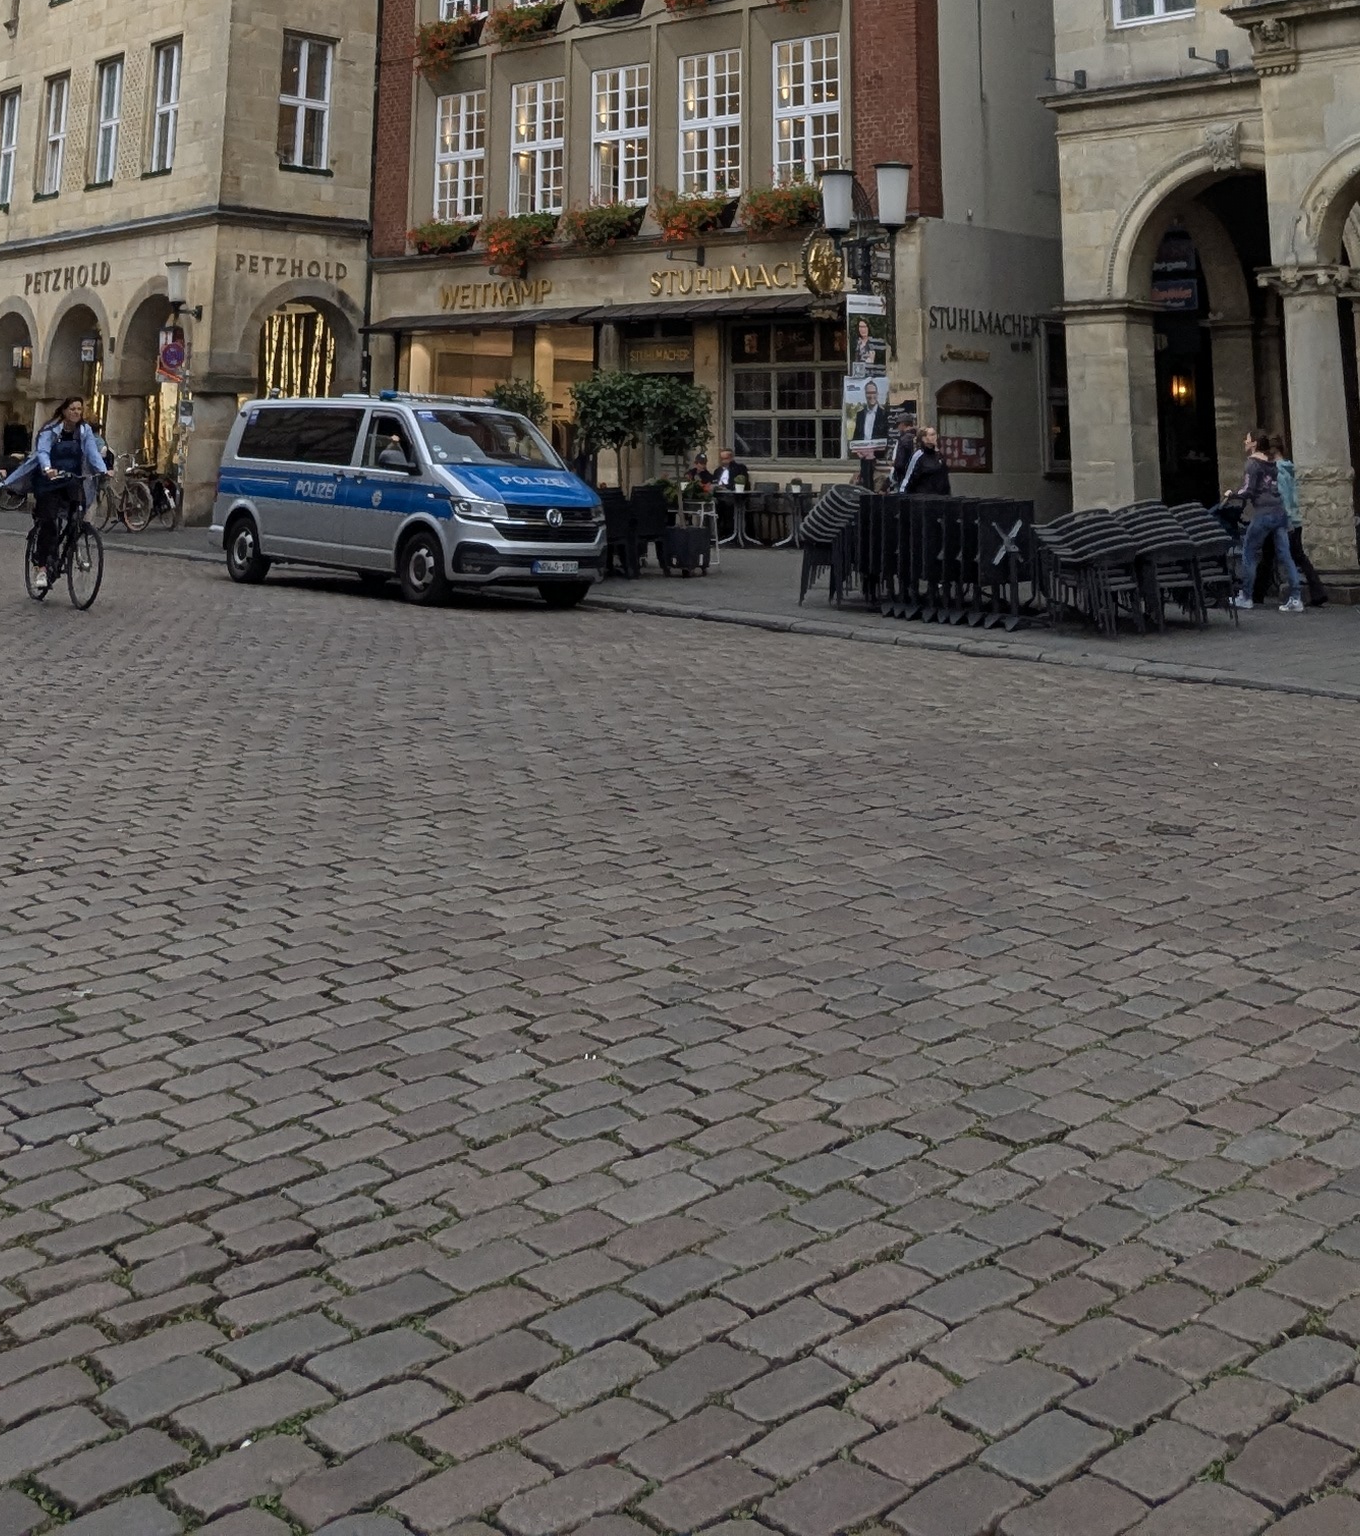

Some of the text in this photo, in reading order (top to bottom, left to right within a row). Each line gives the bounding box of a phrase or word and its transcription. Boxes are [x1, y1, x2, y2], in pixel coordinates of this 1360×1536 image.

[24, 261, 111, 295] PETZHOLD
[235, 253, 348, 282] PETZHOLD
[650, 262, 807, 296] STUHLMACH
[441, 278, 552, 311] WEITKAMP
[929, 305, 1042, 338] STUHLMACHER
[295, 479, 338, 500] POLIZEI
[500, 475, 570, 488] POLIZEI
